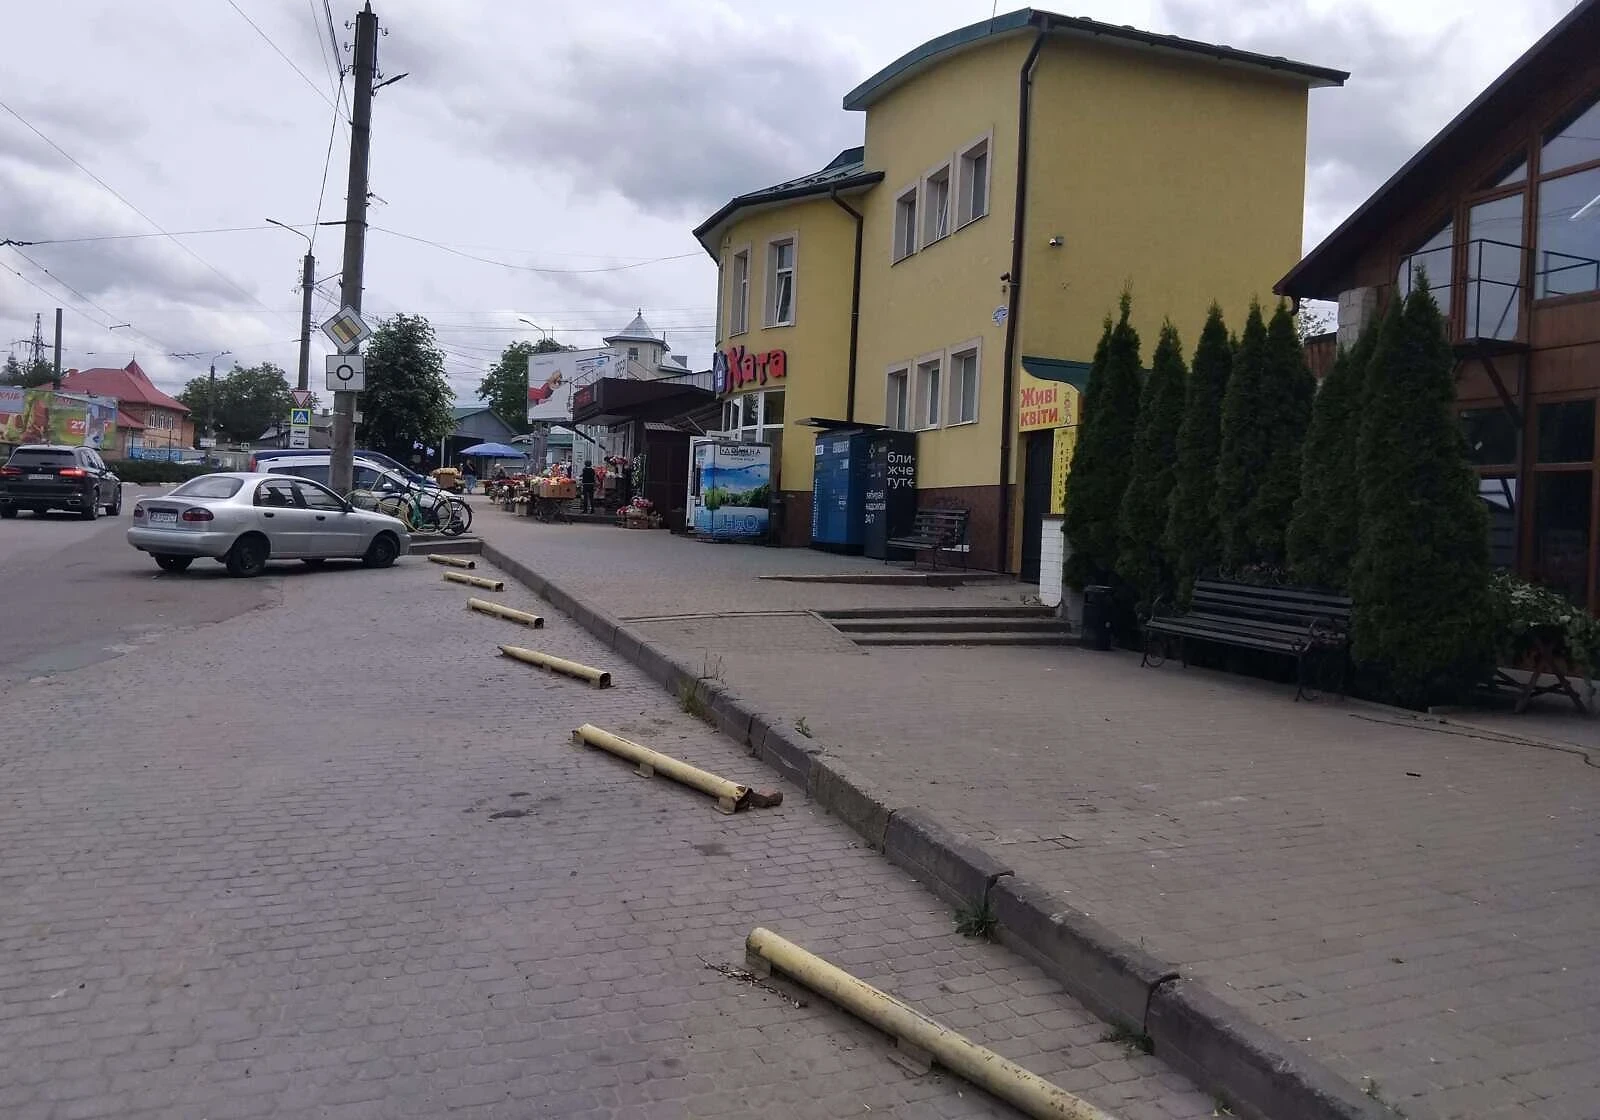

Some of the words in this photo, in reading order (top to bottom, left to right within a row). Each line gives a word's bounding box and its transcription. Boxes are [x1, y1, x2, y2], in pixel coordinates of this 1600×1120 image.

[727, 345, 787, 394] Хата
[1021, 383, 1058, 408] Живі
[887, 466, 914, 476] жче
